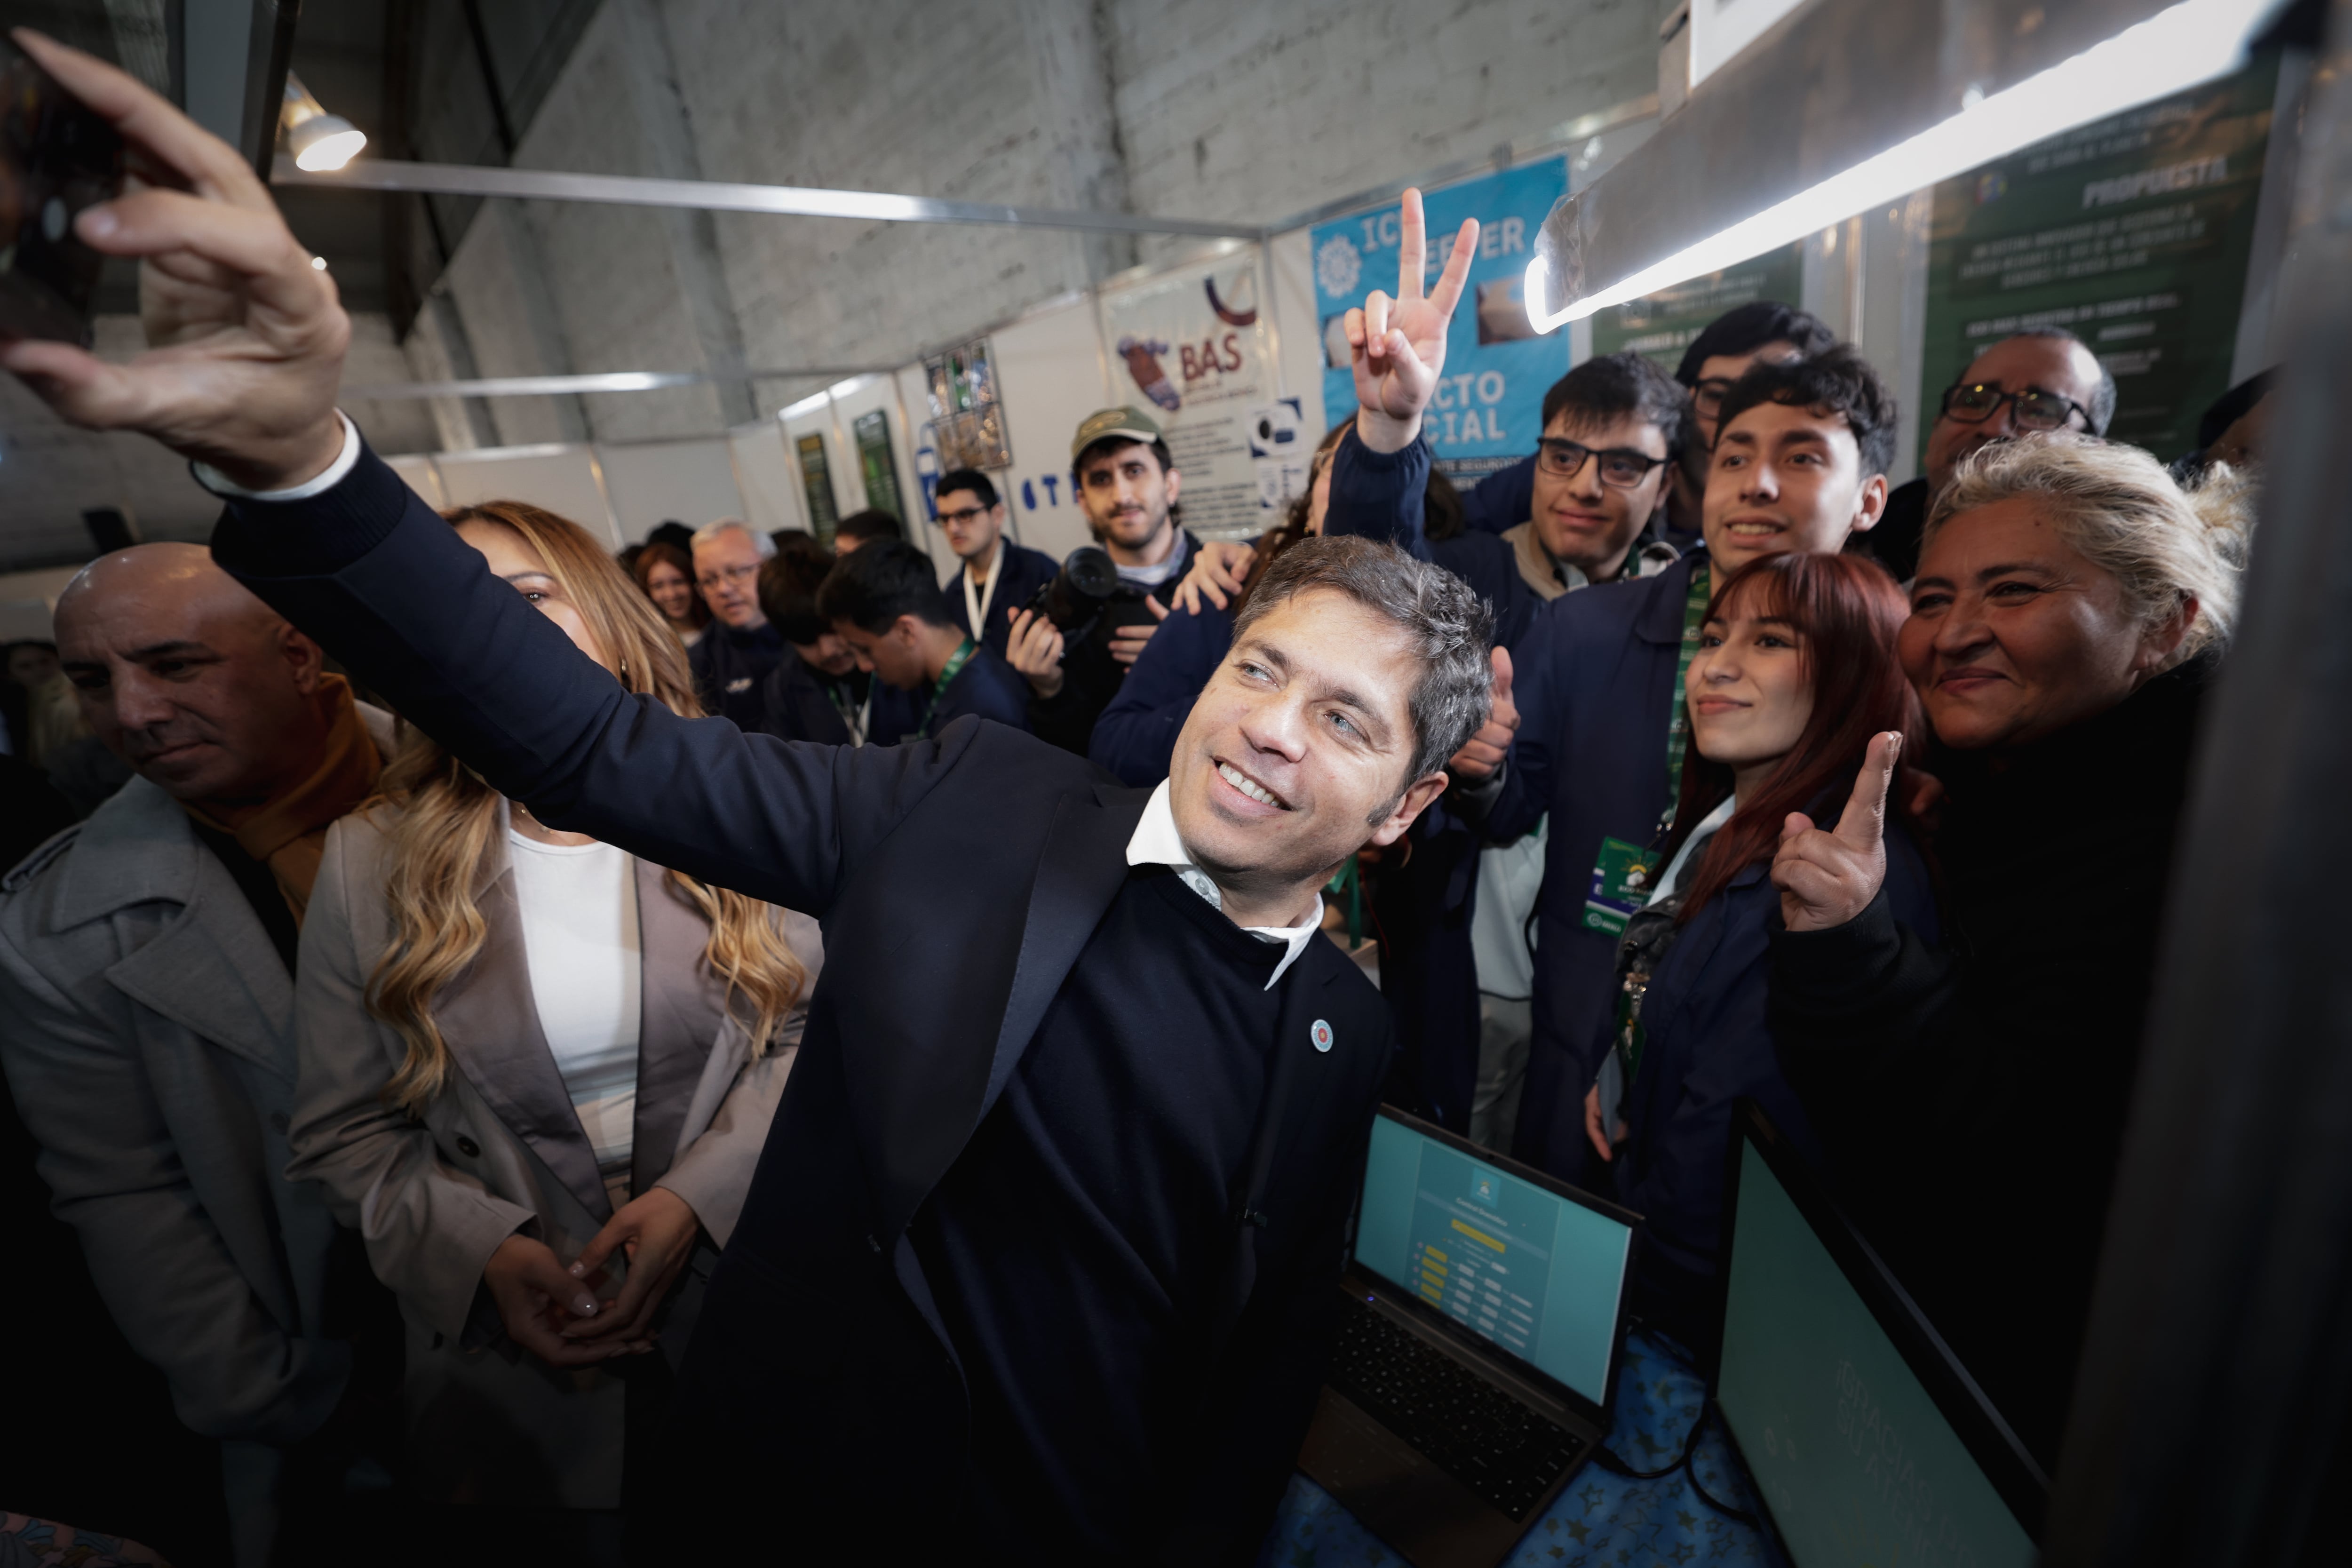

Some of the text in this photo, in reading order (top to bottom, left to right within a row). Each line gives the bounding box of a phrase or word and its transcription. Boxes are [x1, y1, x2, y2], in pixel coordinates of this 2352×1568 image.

[2082, 156, 2227, 209] PROPUESTA
[1359, 211, 1402, 253] IC
[1400, 215, 1526, 275] EEER
[1180, 333, 1243, 381] BAS
[1422, 407, 1507, 446] CIAL
